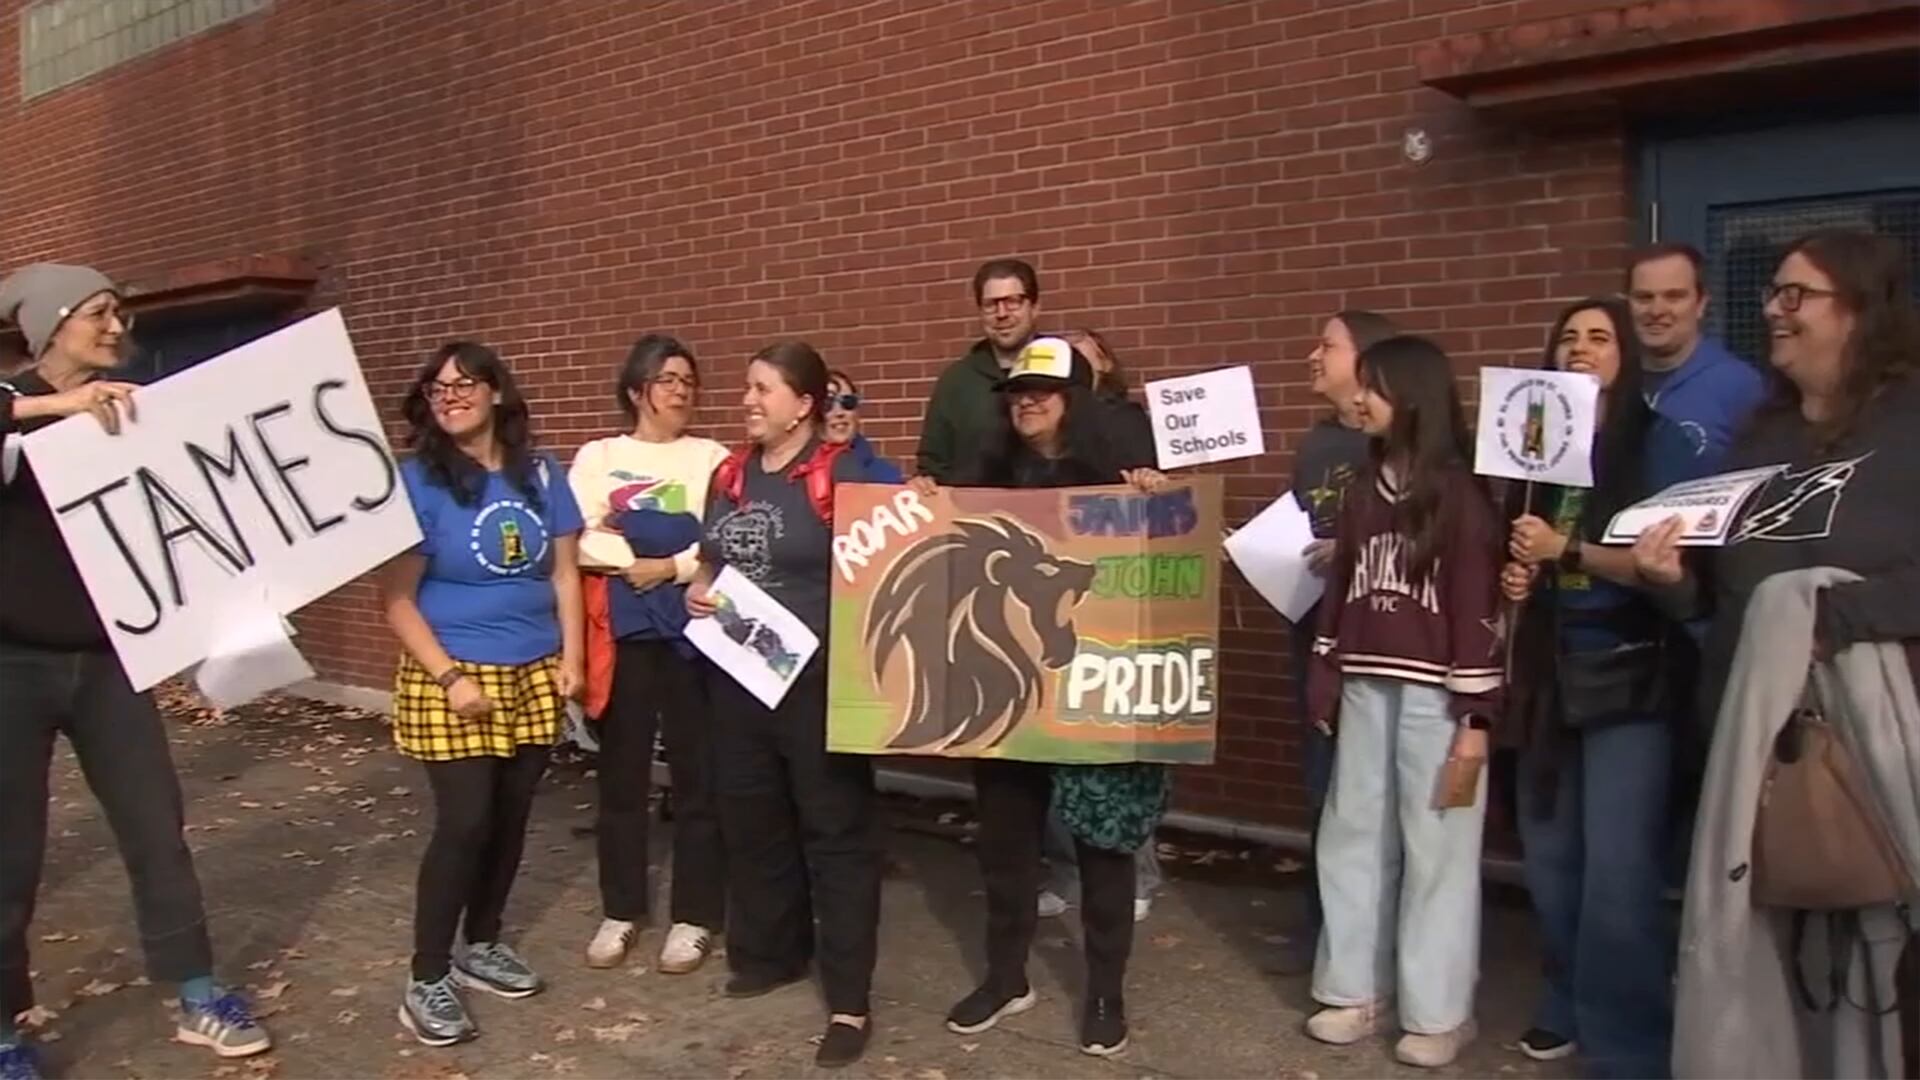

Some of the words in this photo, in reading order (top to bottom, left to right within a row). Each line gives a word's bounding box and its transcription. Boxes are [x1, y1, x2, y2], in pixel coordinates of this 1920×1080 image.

[1160, 386, 1206, 406] Save
[1164, 413, 1200, 430] Our
[1169, 430, 1248, 455] Schools
[55, 378, 397, 635] JAMES
[832, 489, 935, 583] ROAR
[1092, 553, 1204, 598] JOHN
[1067, 649, 1214, 716] PRIDE
